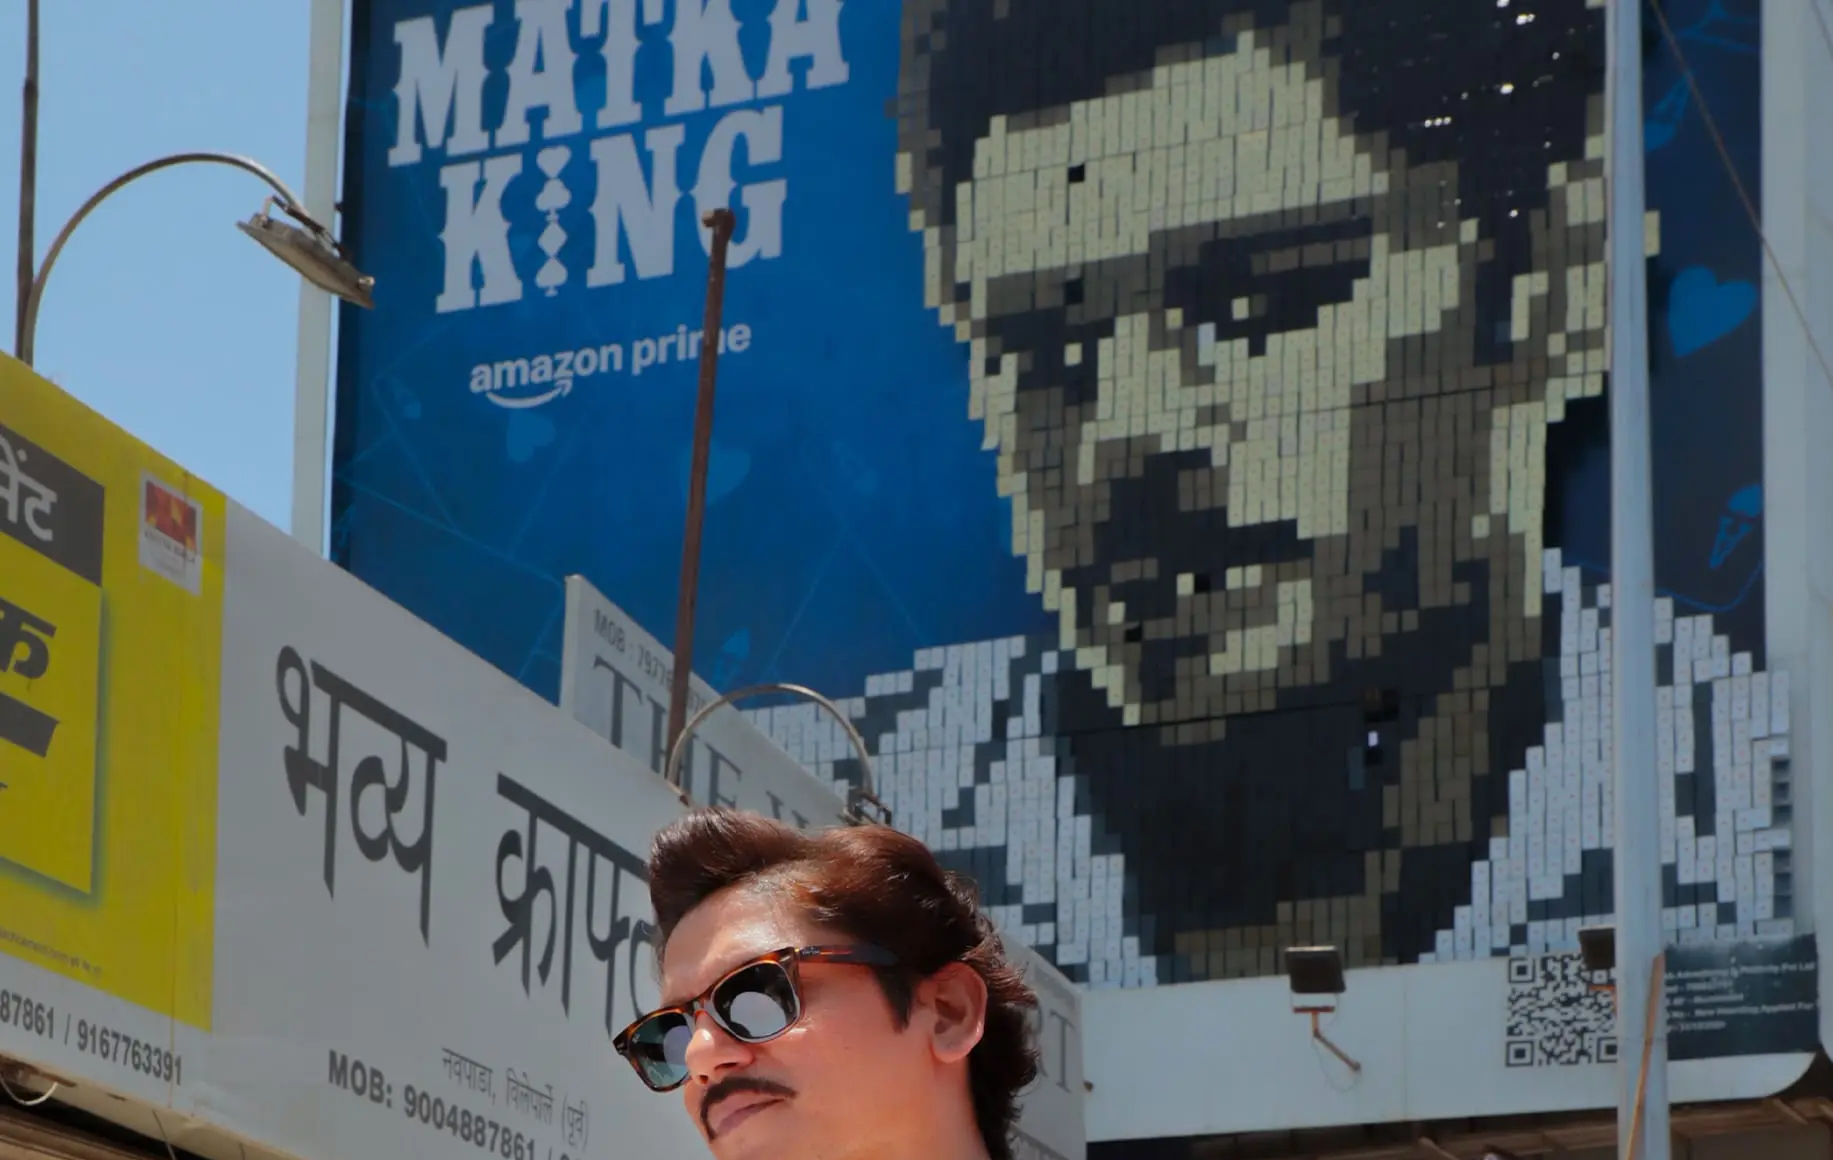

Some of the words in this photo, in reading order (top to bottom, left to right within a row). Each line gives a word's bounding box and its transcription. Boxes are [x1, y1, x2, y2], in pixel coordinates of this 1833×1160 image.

[388, 0, 850, 167] MATKA
[469, 342, 623, 394] amazon
[77, 1018, 182, 1087] 9167763391
[328, 1050, 394, 1109] MOB:
